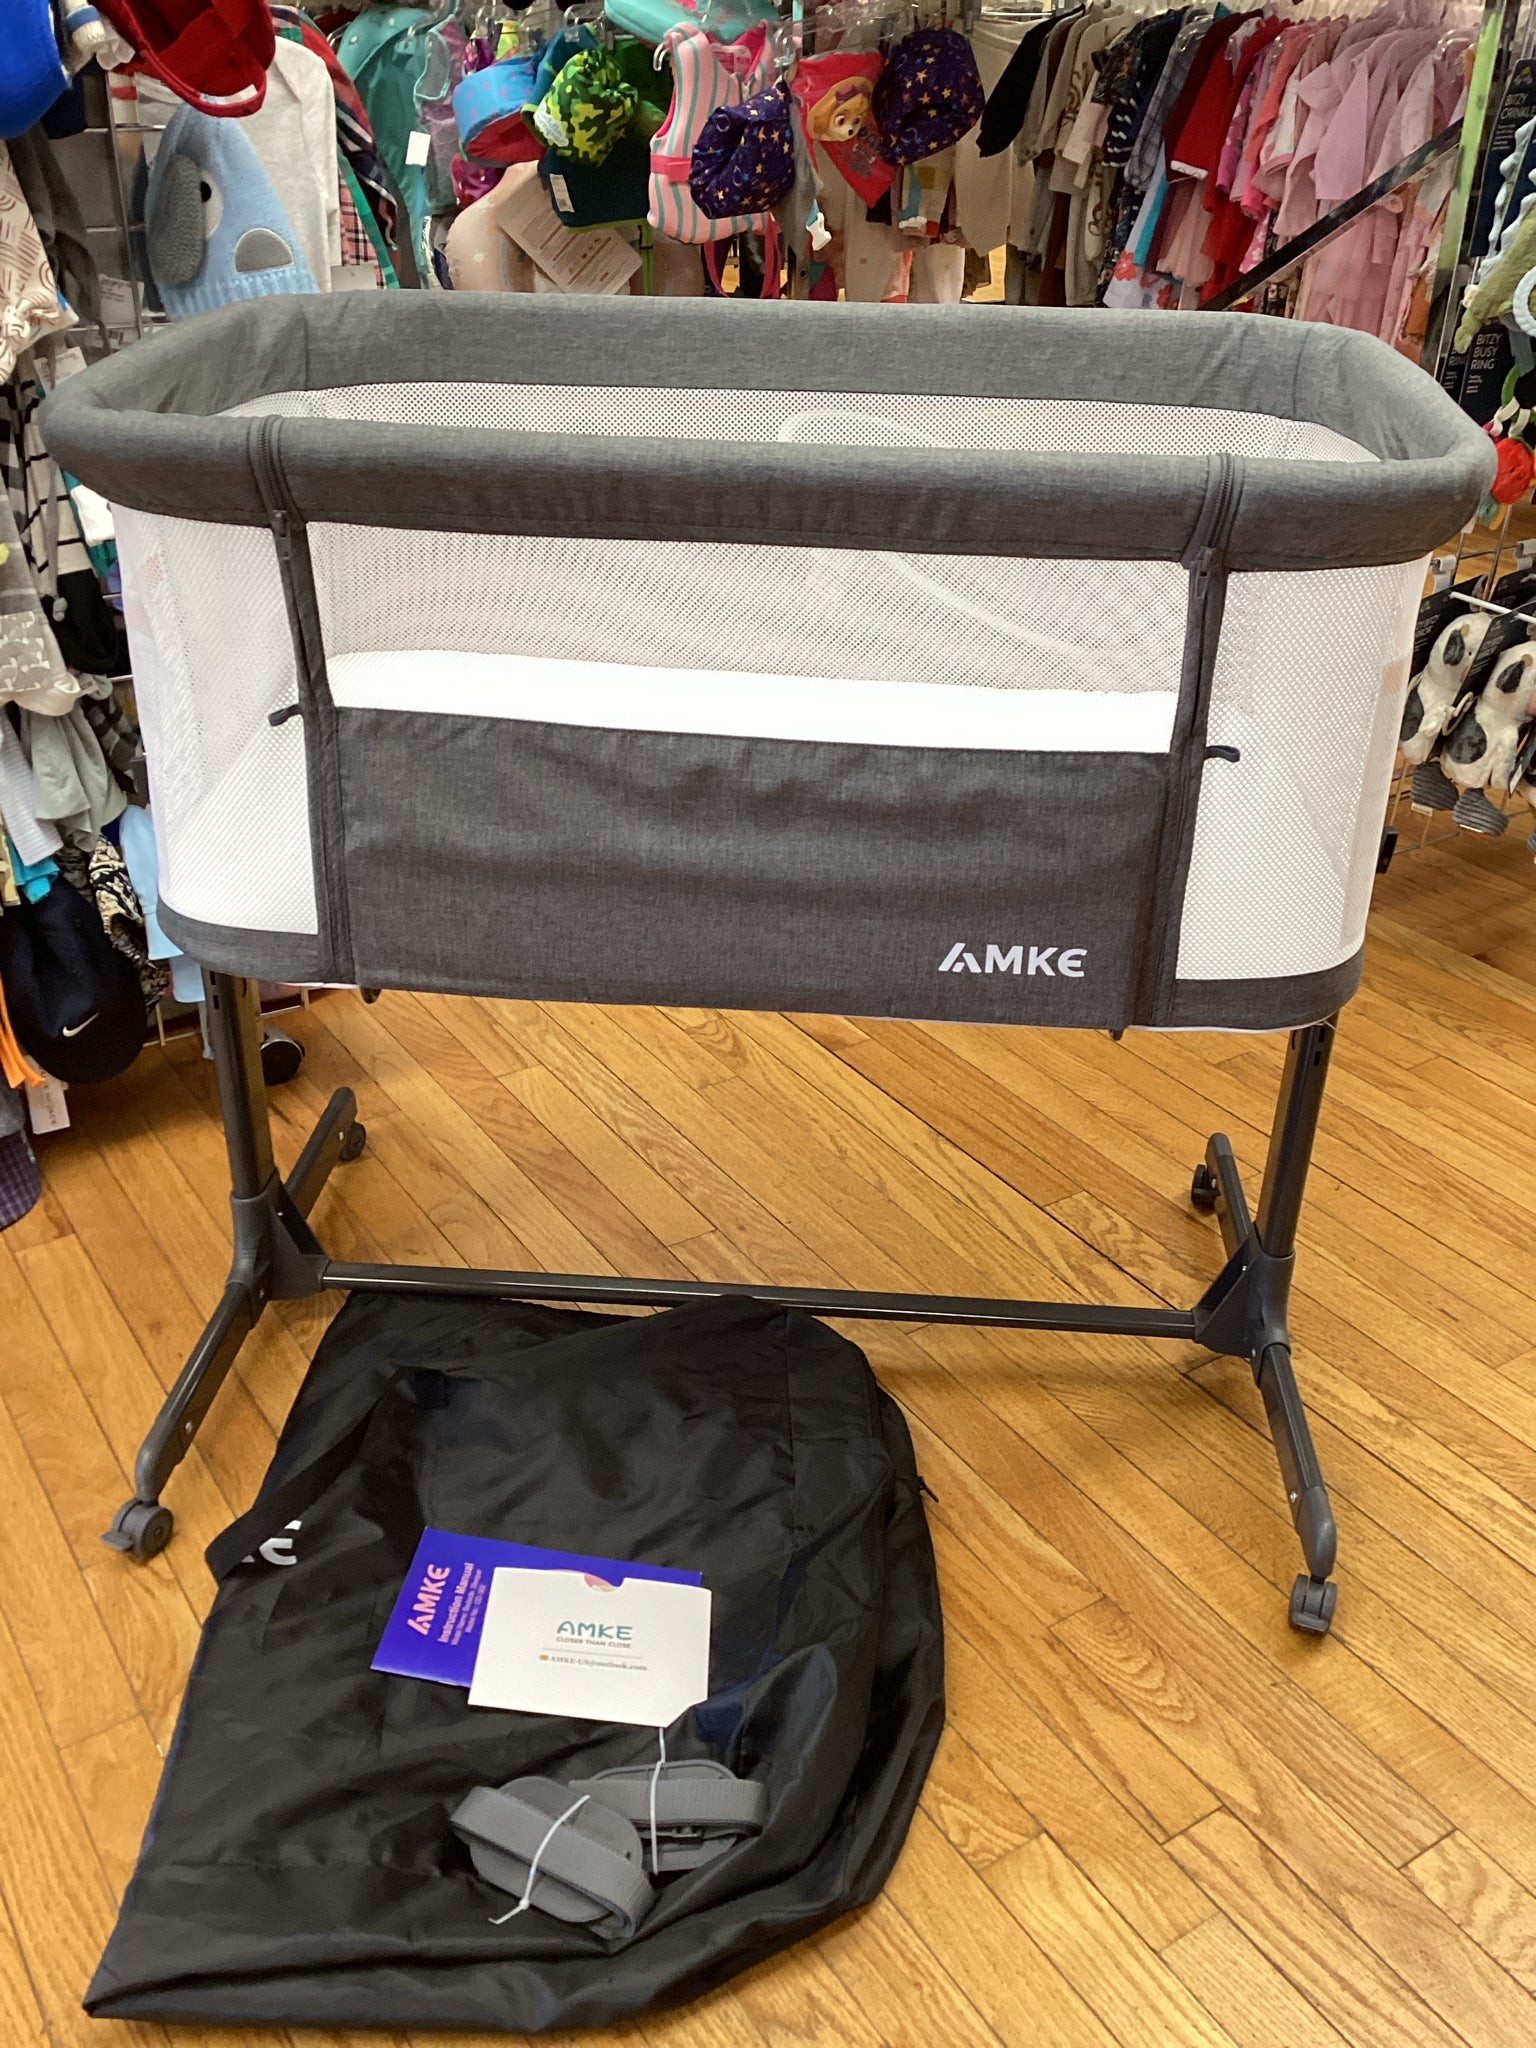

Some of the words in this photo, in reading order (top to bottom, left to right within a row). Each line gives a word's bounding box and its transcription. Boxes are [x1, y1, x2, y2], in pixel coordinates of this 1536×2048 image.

[1476, 333, 1503, 345] BITZY
[1473, 346, 1499, 358] BUSY
[1470, 358, 1495, 370] RING
[937, 942, 1088, 978] AMKE
[407, 1563, 451, 1636] AMKE
[437, 1595, 463, 1643] Instruction
[454, 1562, 474, 1595] Manual
[556, 1620, 633, 1641] AMKE
[555, 1636, 584, 1645] CLOSER
[585, 1639, 606, 1647] THAN
[608, 1641, 632, 1649] CLOSE
